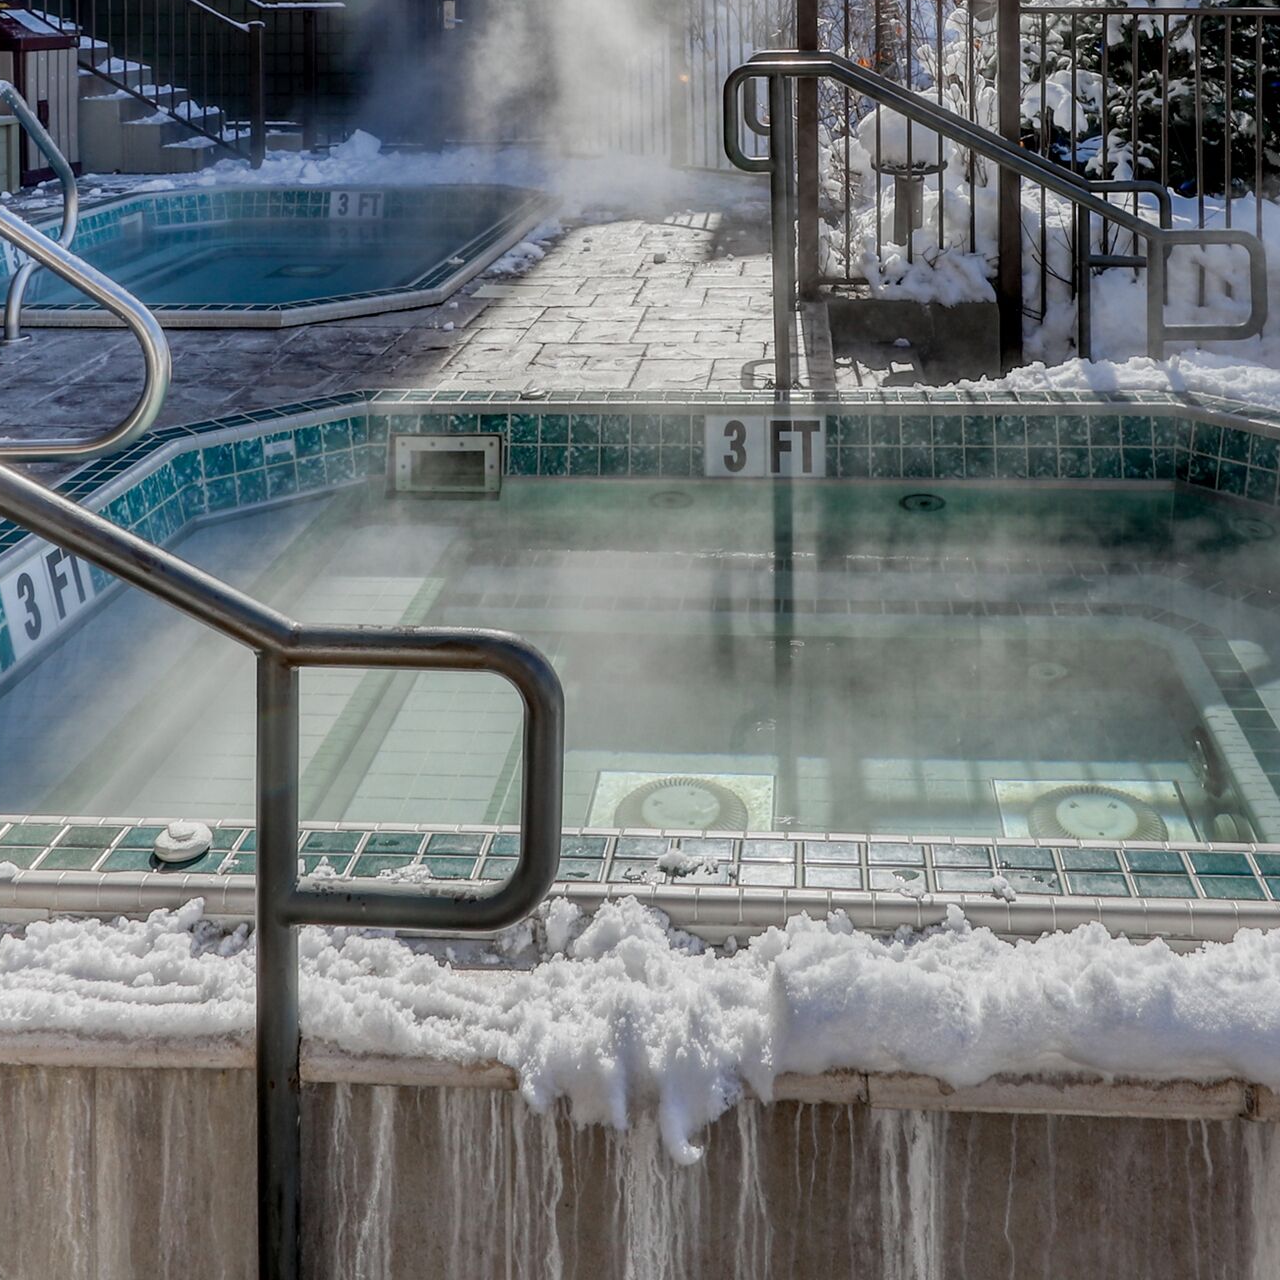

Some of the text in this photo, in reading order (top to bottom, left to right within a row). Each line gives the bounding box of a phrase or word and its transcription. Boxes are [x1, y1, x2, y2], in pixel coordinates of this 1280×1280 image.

[337, 192, 381, 216] 3 FT
[723, 420, 820, 473] 3 FT
[16, 572, 42, 641] 3
